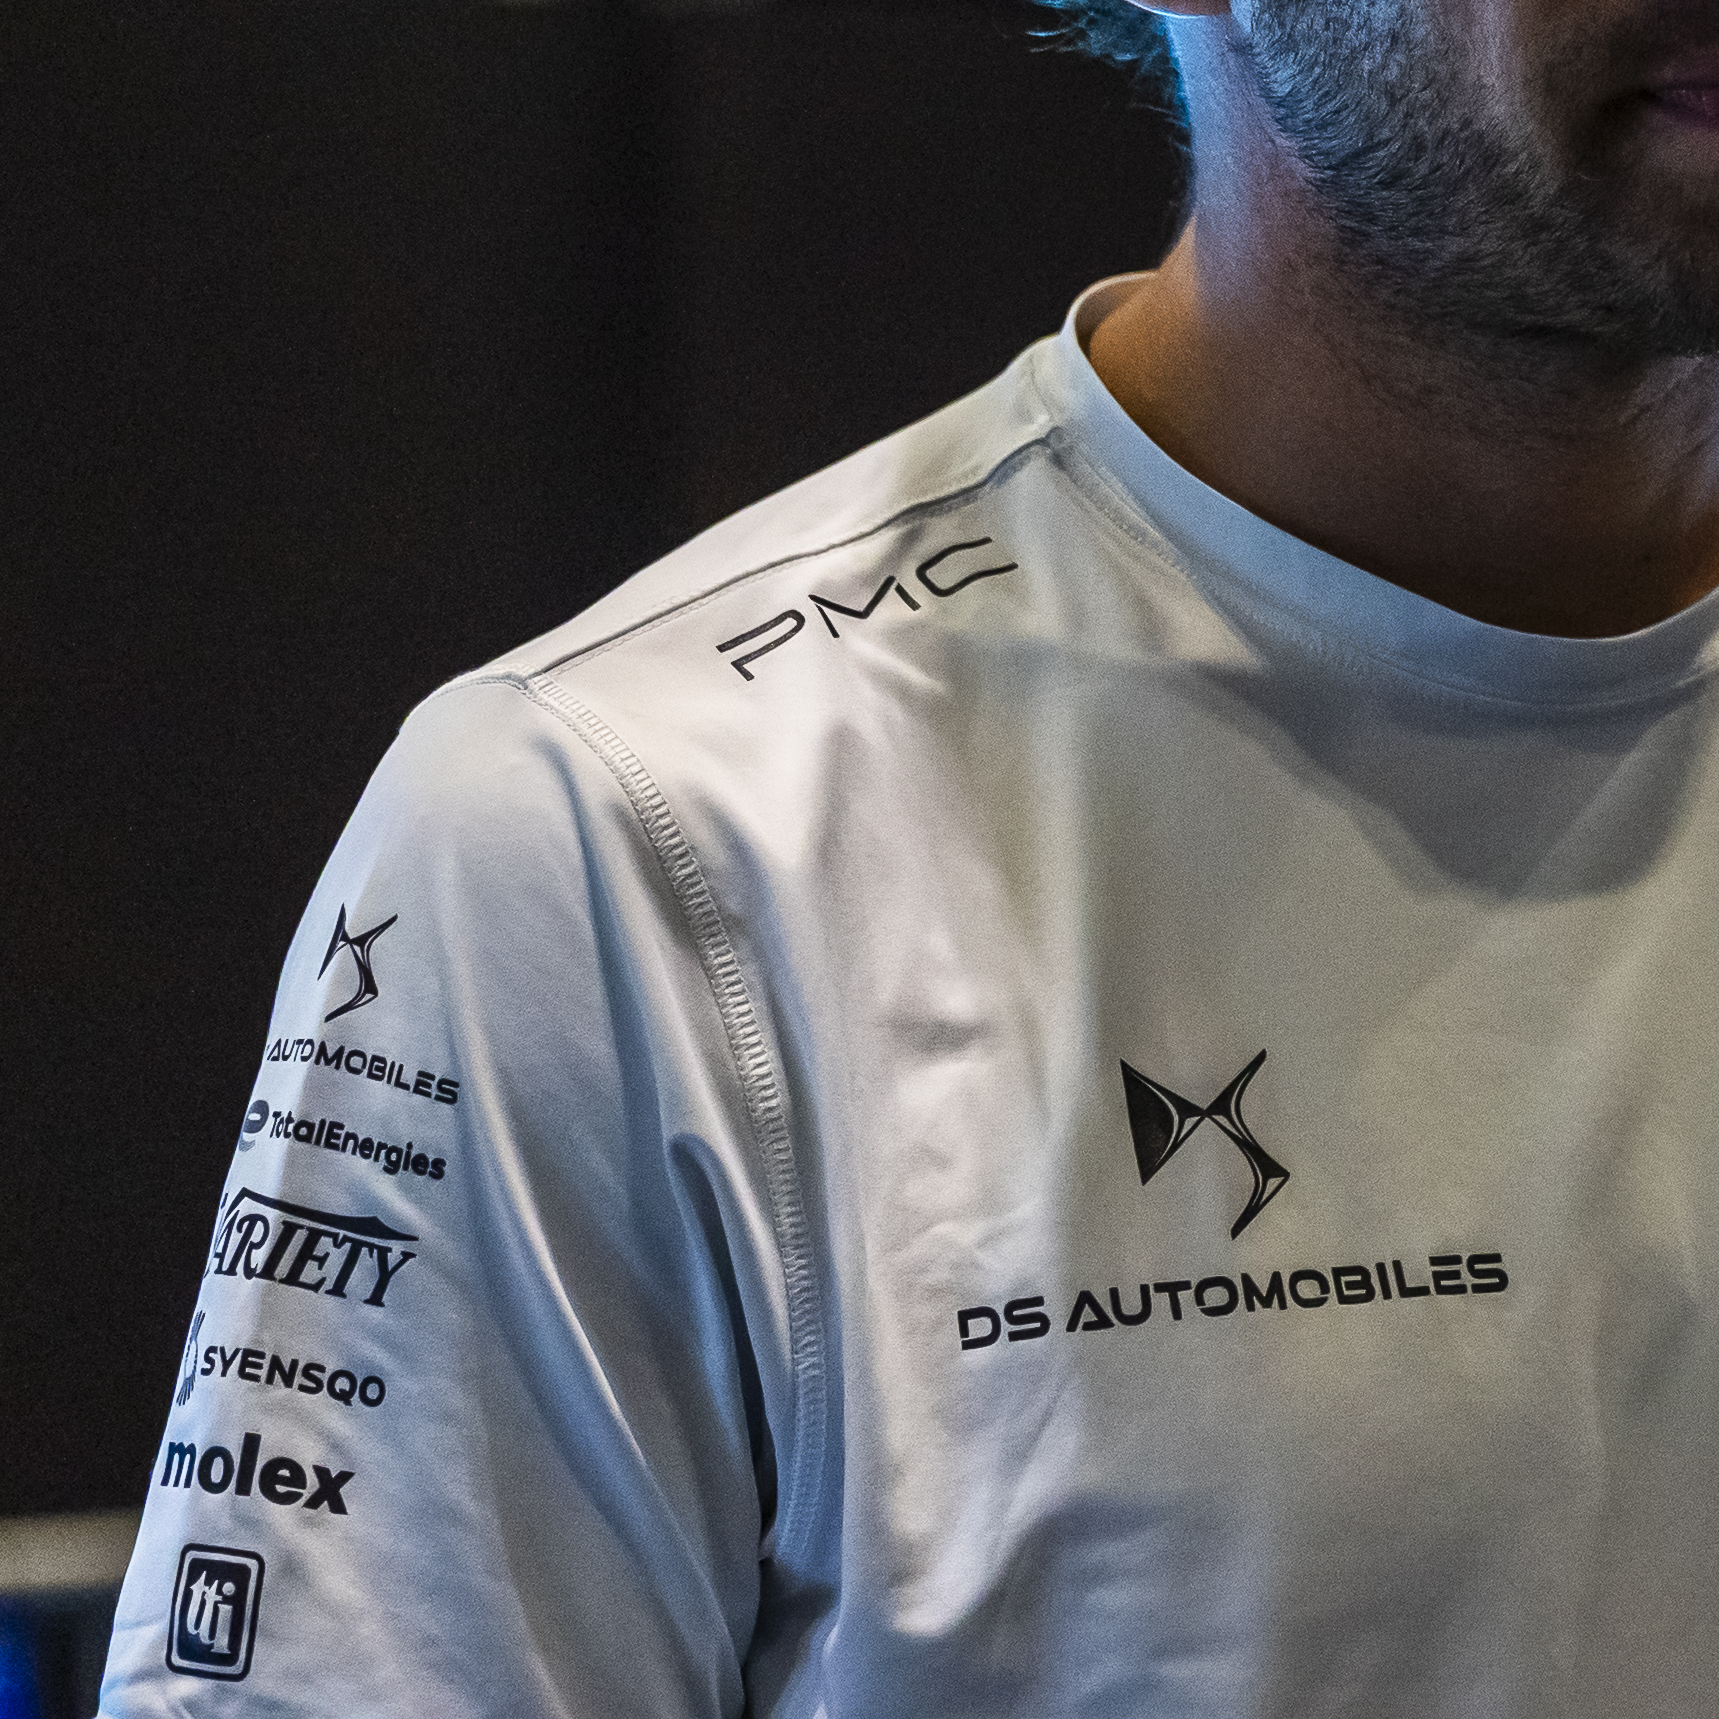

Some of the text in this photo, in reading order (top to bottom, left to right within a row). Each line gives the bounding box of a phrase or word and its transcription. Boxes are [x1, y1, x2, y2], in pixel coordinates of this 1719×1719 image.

[715, 536, 1019, 683] PMC
[267, 1038, 461, 1106] AUTOMOBILES
[269, 1110, 448, 1181] TotalEnergies
[203, 1190, 420, 1308] ARIETY
[957, 1252, 1510, 1352] DS AUTOMOBILES
[199, 1344, 388, 1409] SYENSQO
[160, 1431, 357, 1516] molex
